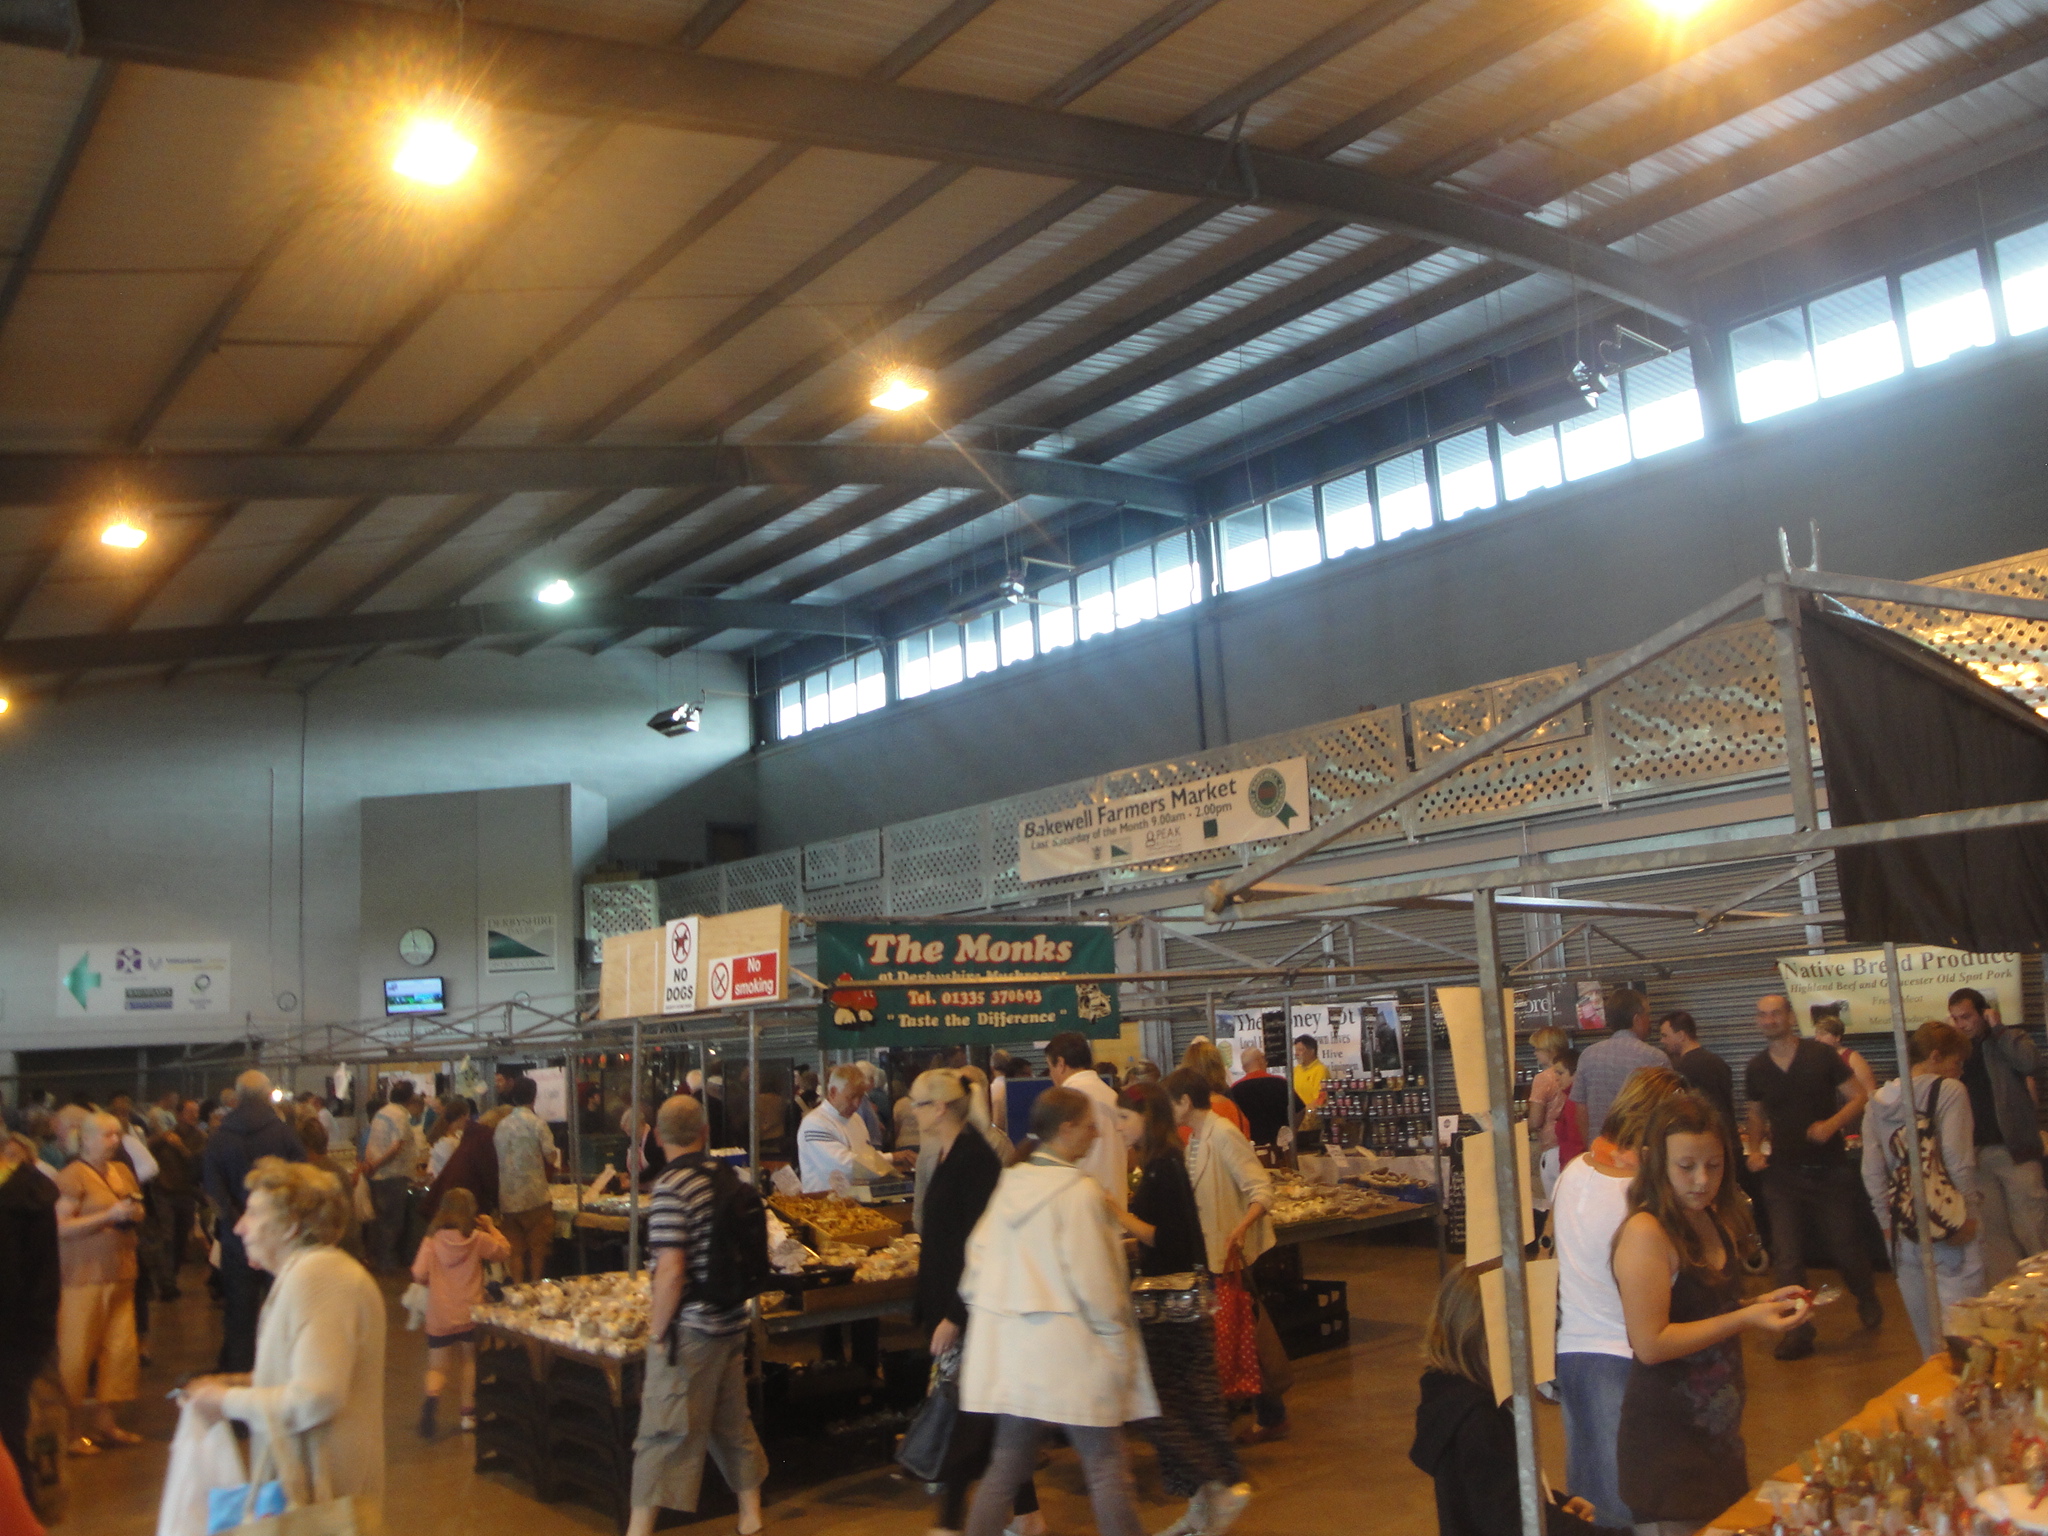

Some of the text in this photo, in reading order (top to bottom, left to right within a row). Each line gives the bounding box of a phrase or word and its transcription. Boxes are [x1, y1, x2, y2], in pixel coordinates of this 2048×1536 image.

[1025, 809, 1093, 838] Bakewell
[1097, 798, 1166, 825] Farmers
[1171, 778, 1238, 810] Market
[1031, 840, 1048, 850] Last
[1092, 829, 1101, 839] of
[1103, 826, 1117, 837] the
[1120, 819, 1149, 834] Month
[1151, 811, 1186, 827] 9.00am
[1195, 802, 1232, 818] 2.00pm
[1156, 827, 1180, 838] PEAK
[866, 933, 1074, 965] The Monks
[747, 957, 761, 973] No
[1785, 951, 2014, 980] Native Bred Produce
[673, 967, 688, 983] NO
[1791, 982, 1834, 994] Highland
[1836, 981, 1857, 992] Beef
[1859, 980, 1876, 989] and
[1937, 973, 1956, 984] Old
[1959, 972, 1983, 984] Spot
[1987, 969, 2013, 980] Pork
[666, 985, 694, 1001] DOGS
[734, 977, 774, 996] smoking
[907, 988, 1043, 1008] Tel. 01335 370693
[944, 1013, 971, 1027] the
[1234, 1012, 1262, 1032] The
[1322, 1050, 1343, 1060] Hive
